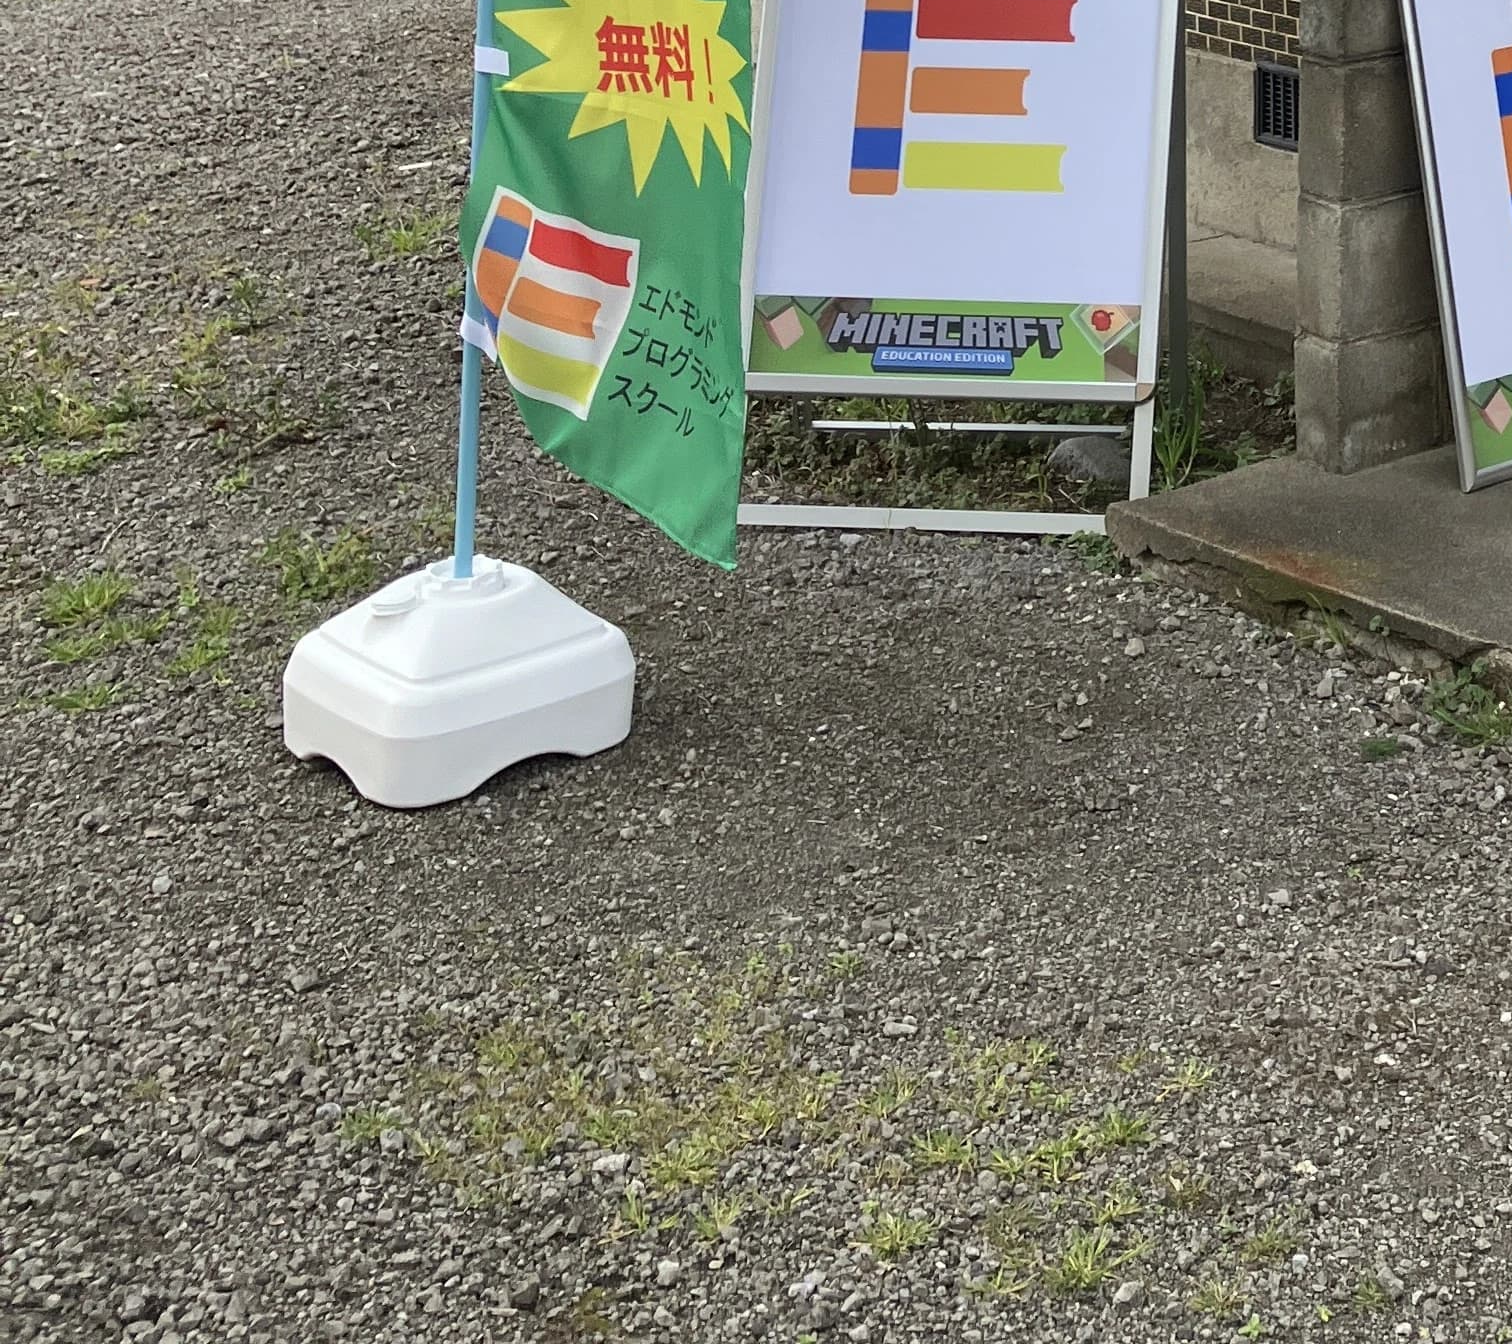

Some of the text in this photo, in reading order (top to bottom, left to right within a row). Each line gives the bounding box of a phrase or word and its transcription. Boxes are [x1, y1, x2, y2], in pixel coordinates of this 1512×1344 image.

[595, 16, 716, 105] 無料！
[638, 284, 717, 348] エドモンド
[827, 311, 1064, 357] MINECRAFT
[622, 328, 735, 418] プログラミング
[880, 350, 1006, 364] EDUCATION EDITION
[607, 374, 695, 437] スクール
